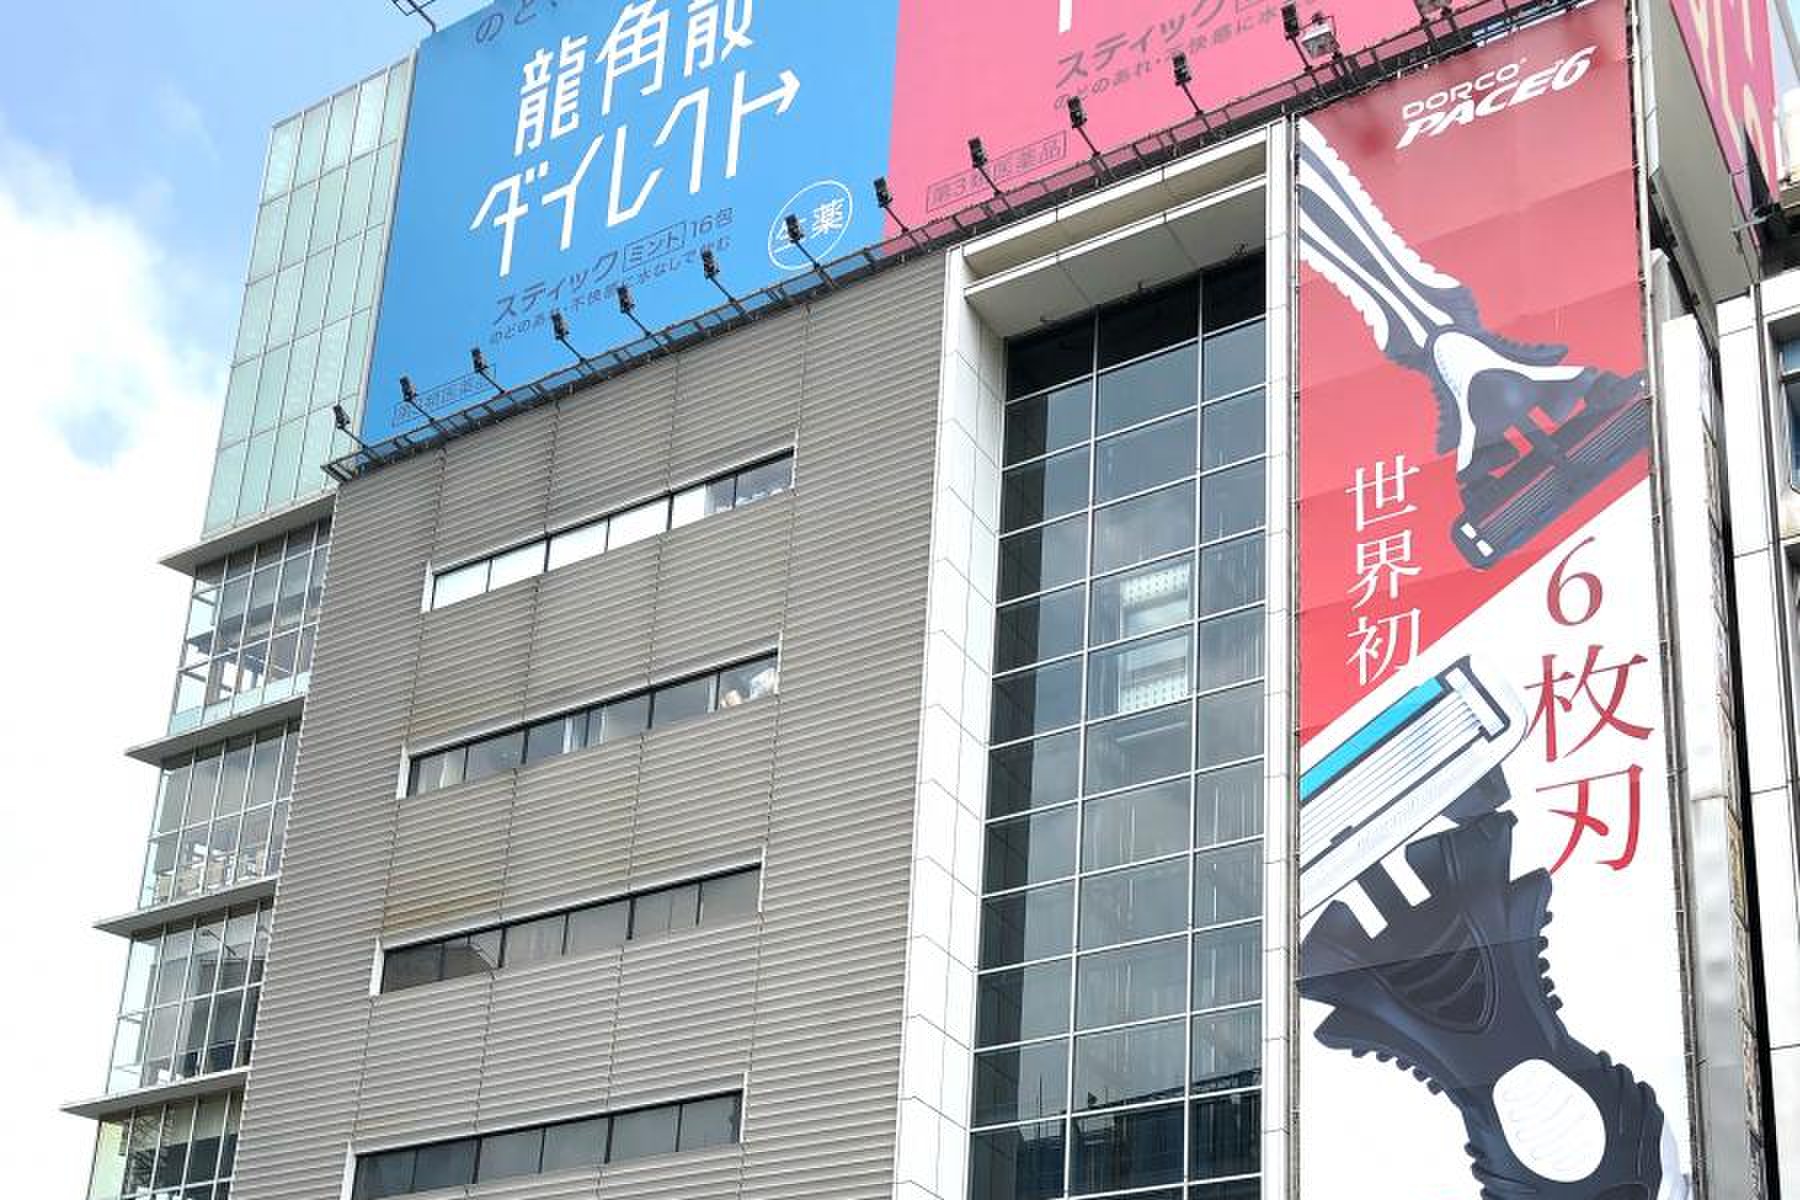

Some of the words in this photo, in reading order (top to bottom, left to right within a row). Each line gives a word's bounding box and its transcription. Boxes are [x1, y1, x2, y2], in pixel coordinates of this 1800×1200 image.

[514, 0, 753, 157] 龍角散
[1402, 63, 1521, 120] DORCO
[470, 70, 801, 277] ダイレクト
[492, 248, 620, 326] スティック
[1345, 454, 1423, 686] 世界初
[1523, 536, 1655, 876] 6枚刃
